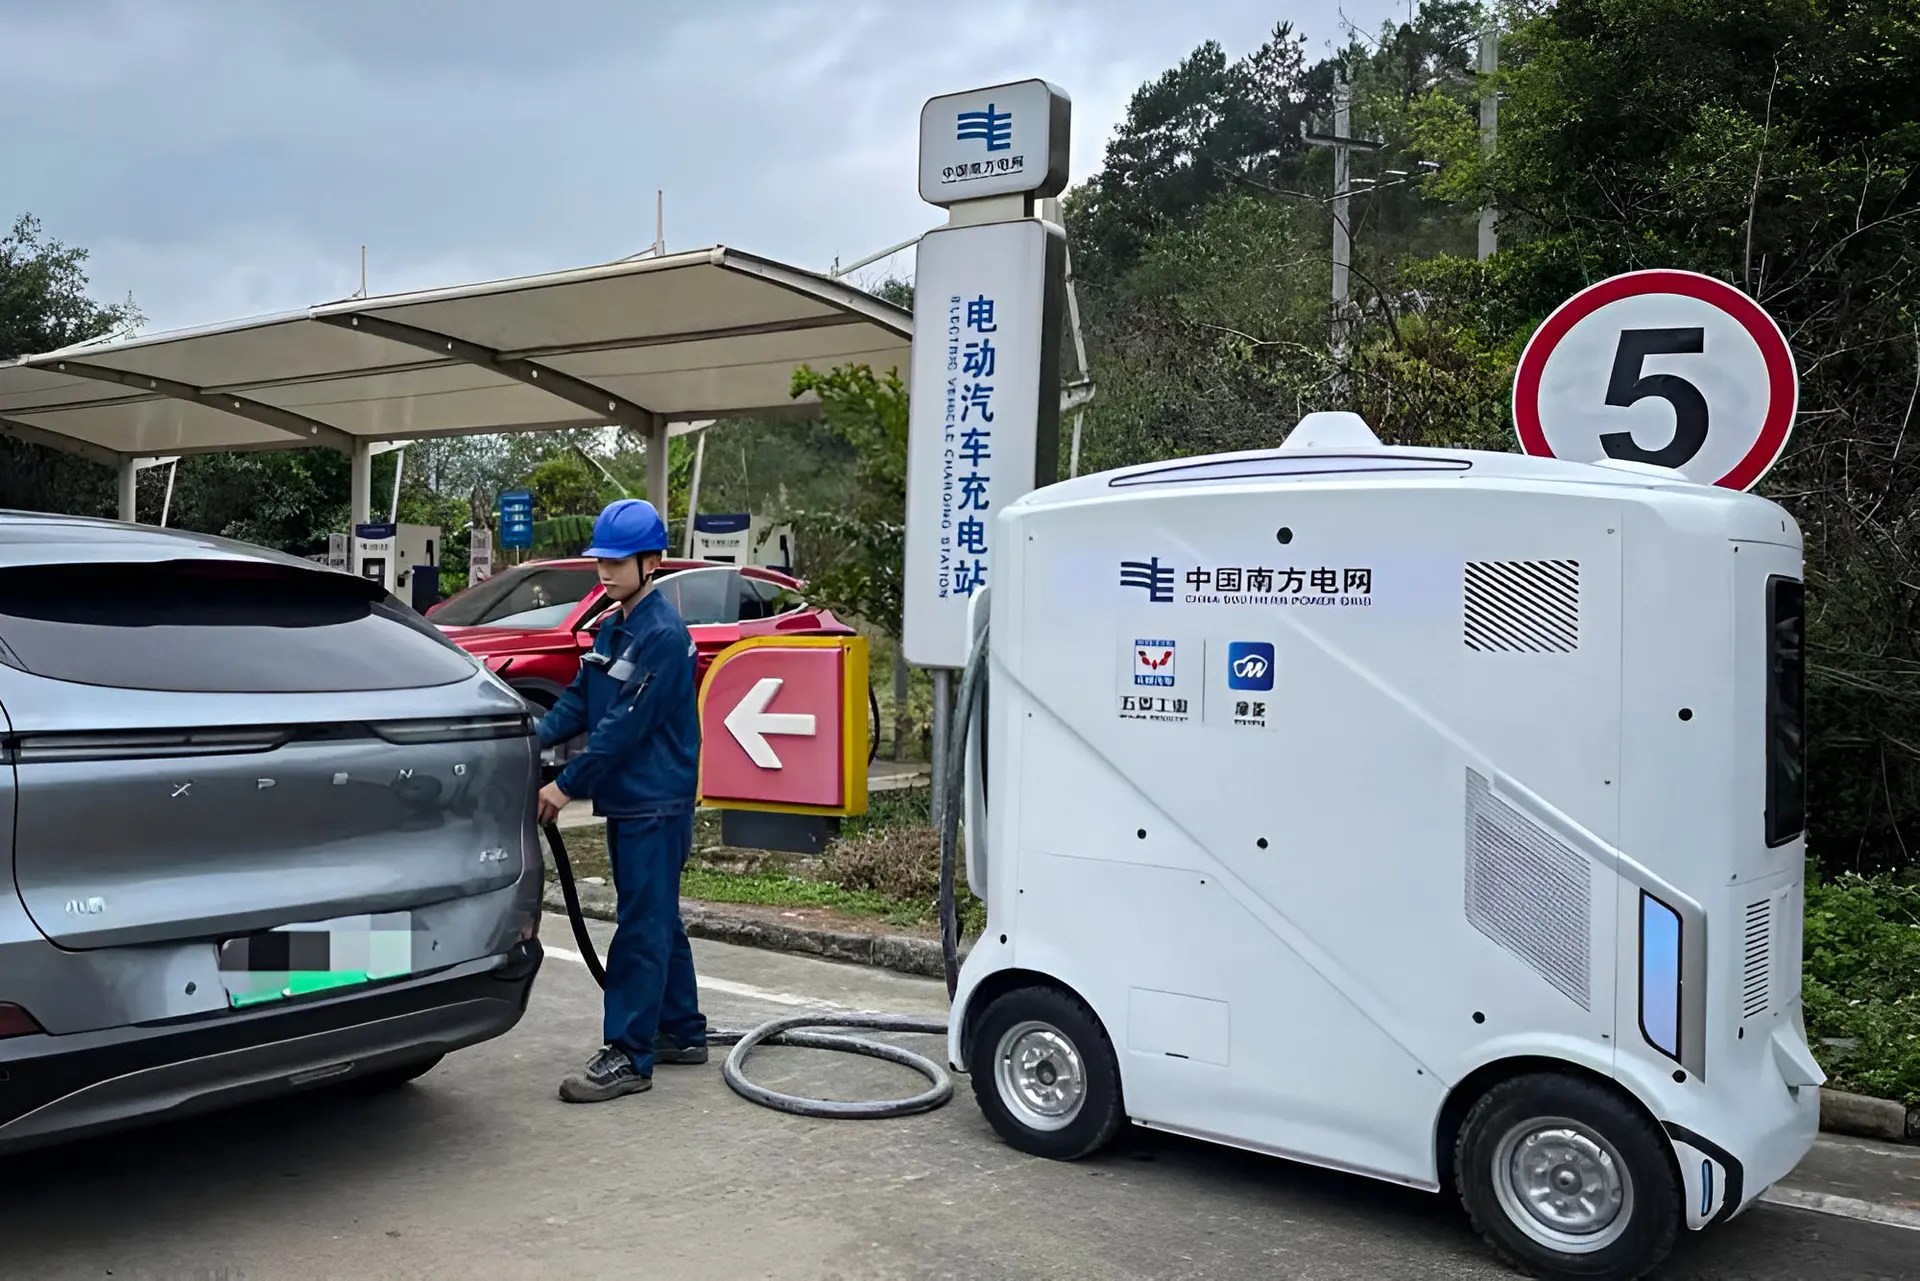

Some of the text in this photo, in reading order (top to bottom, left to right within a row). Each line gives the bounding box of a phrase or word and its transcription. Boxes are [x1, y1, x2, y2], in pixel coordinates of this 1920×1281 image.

[953, 294, 997, 598] 电动汽车充电站
[1599, 327, 1709, 469] 5
[1186, 566, 1372, 594] 中国南方电网
